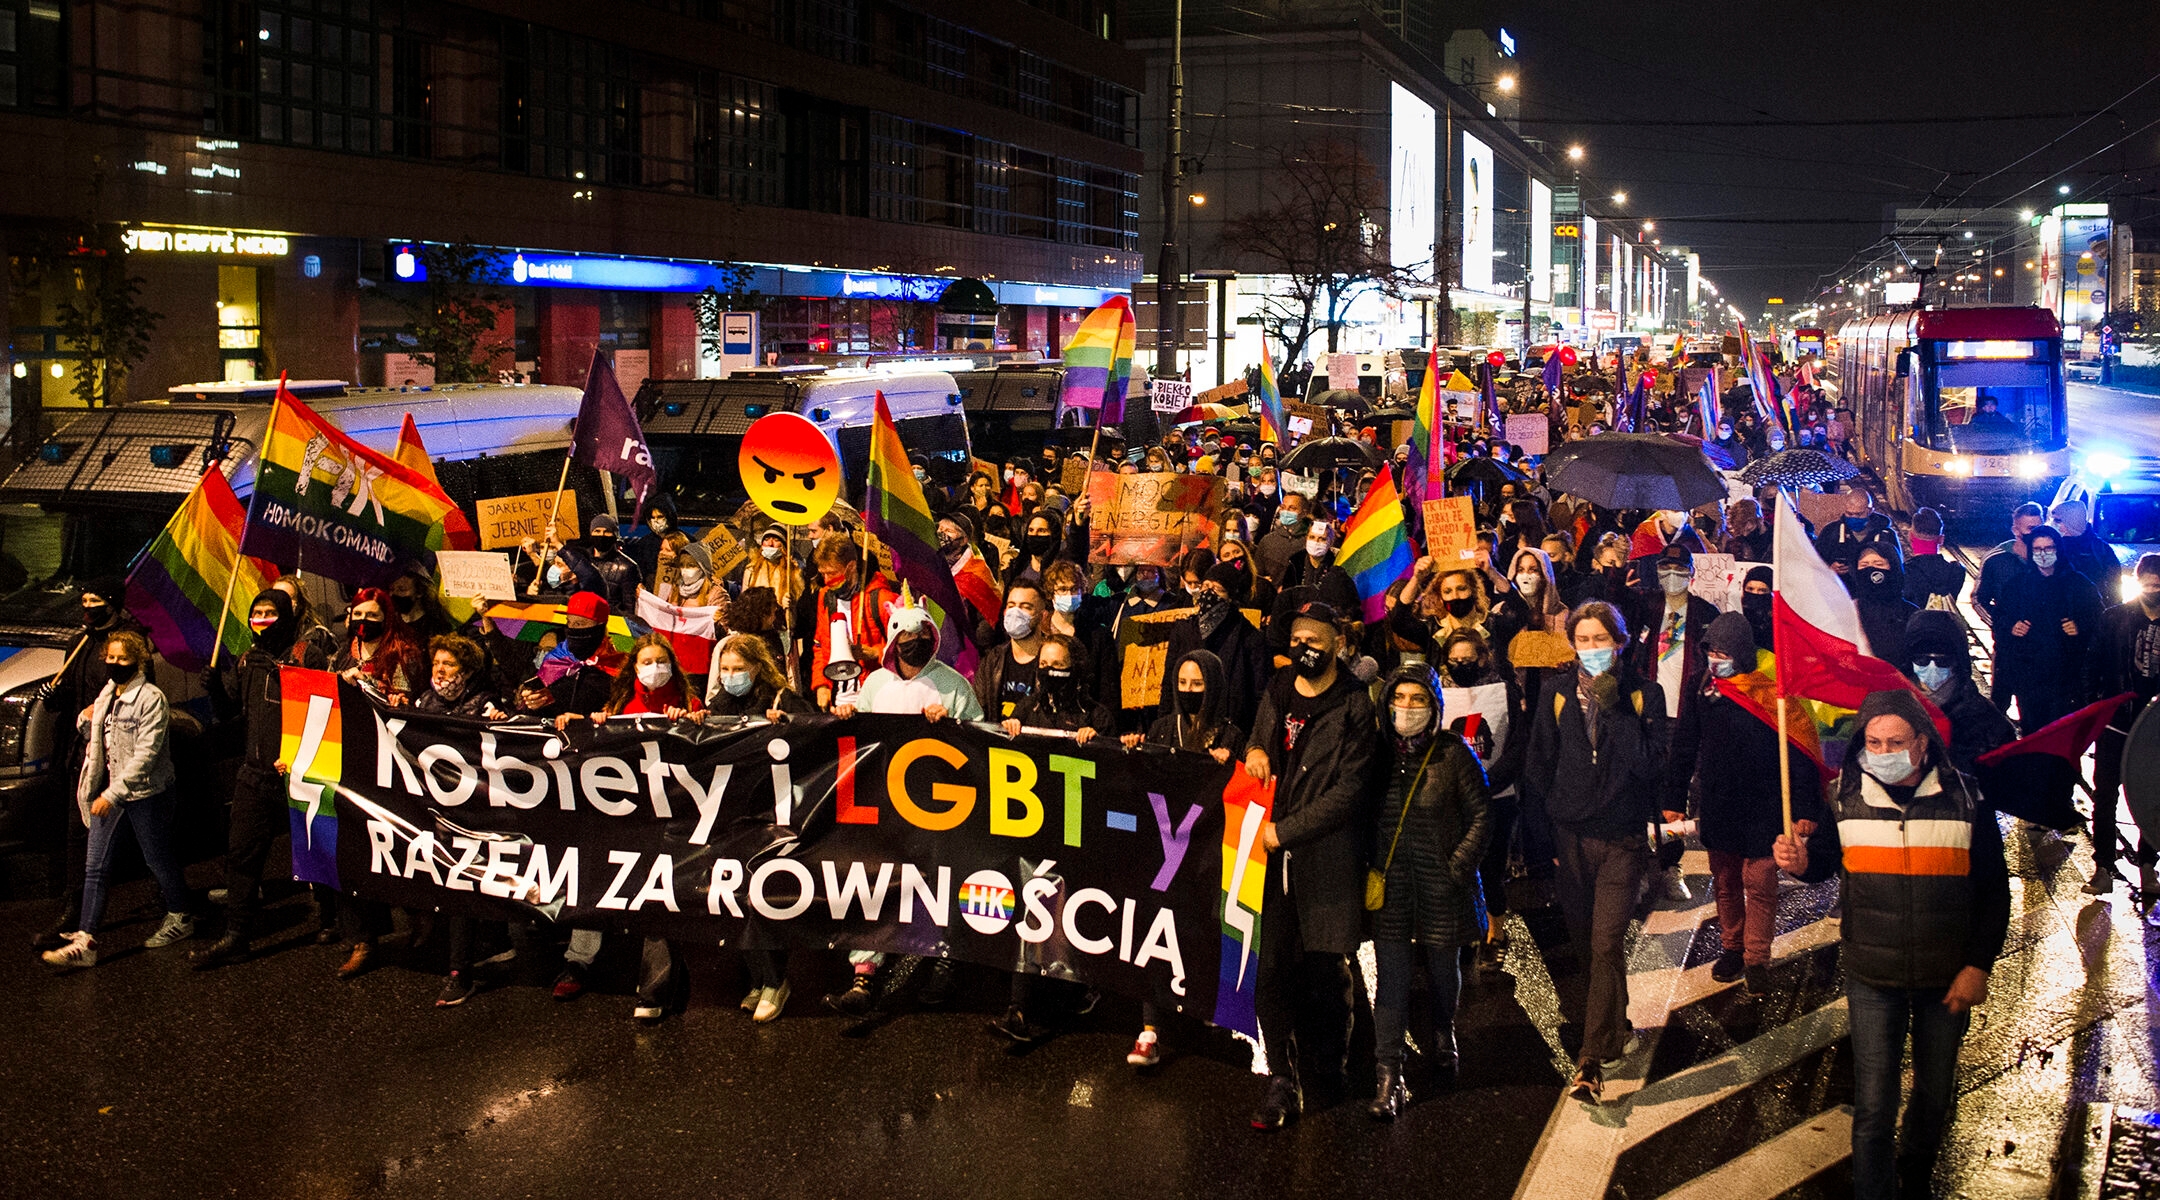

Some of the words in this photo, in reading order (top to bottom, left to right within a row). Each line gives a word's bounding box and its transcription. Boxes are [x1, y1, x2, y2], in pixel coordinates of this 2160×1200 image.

[1157, 382, 1192, 396] PIEKŁO
[1153, 392, 1190, 408] KOBIET
[535, 498, 553, 511] TO
[490, 517, 541, 539] JEBNIE
[1089, 510, 1194, 533] ENERGIA
[1131, 659, 1157, 679] NA
[373, 708, 734, 845] Kobiety
[766, 737, 792, 827] i
[835, 736, 1205, 892] LGBT-y
[366, 819, 579, 908] RAZEM
[595, 849, 682, 913] ZA
